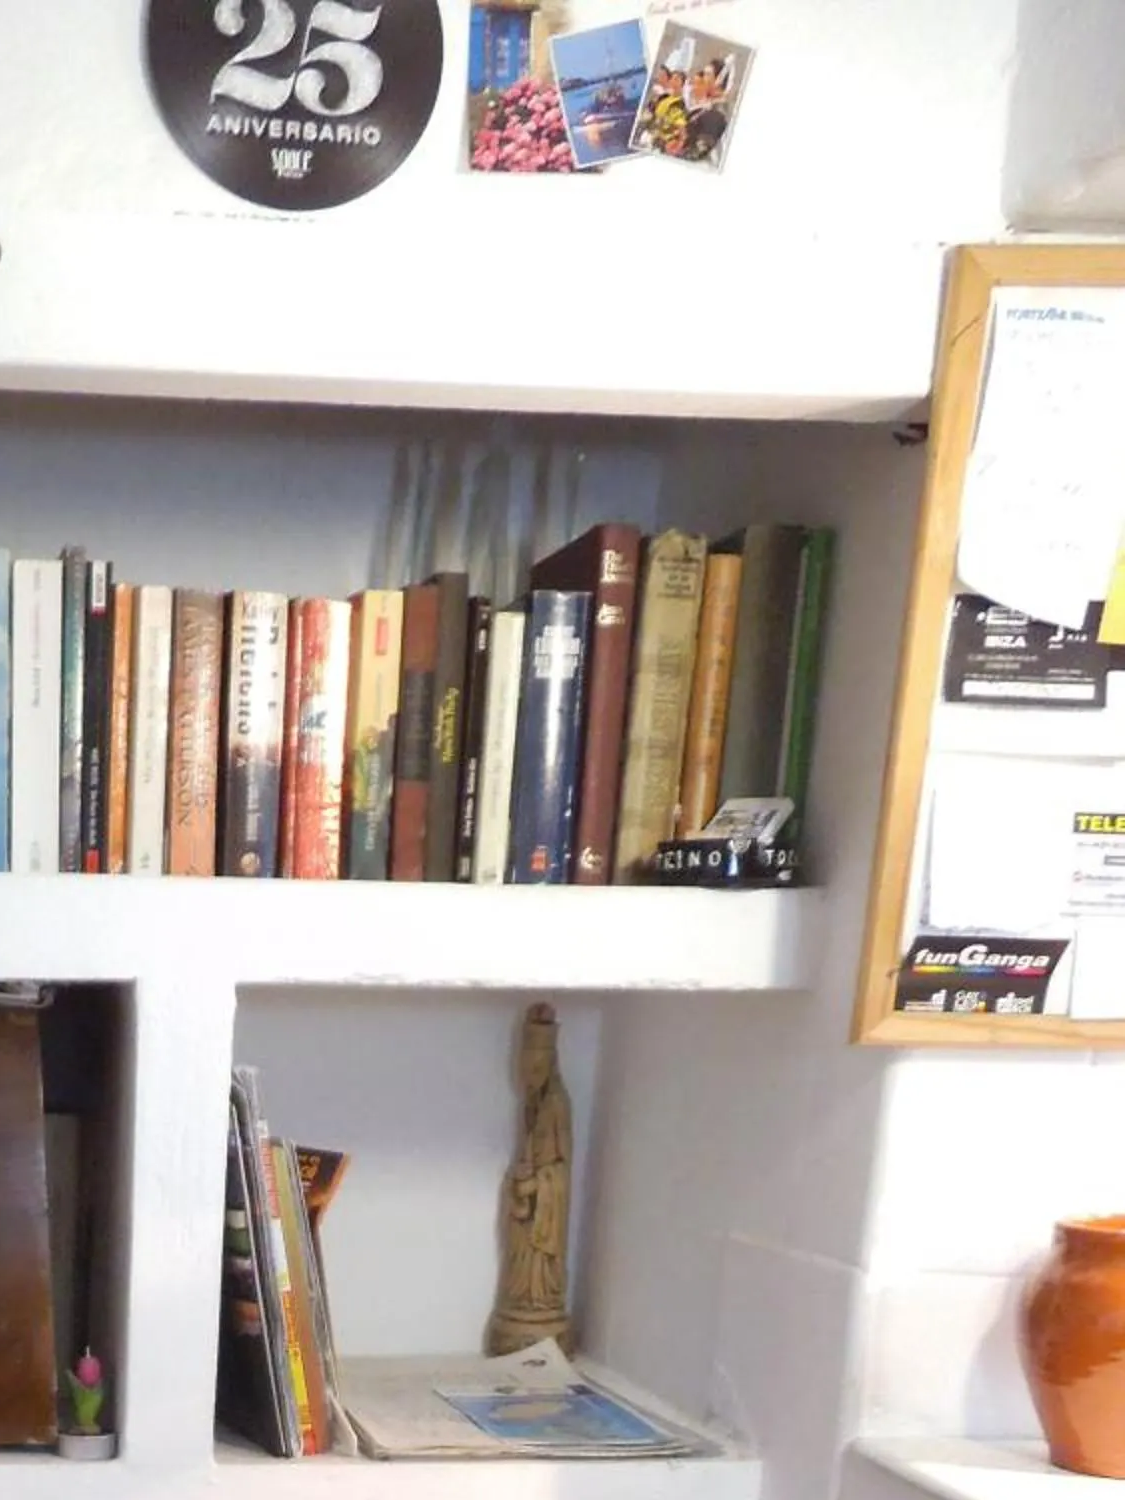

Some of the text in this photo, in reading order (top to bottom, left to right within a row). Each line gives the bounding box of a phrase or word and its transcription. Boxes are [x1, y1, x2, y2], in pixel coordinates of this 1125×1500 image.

[209, 0, 384, 117] 25
[206, 114, 381, 146] ANIVERSARIO
[914, 943, 1051, 968] funGanga
